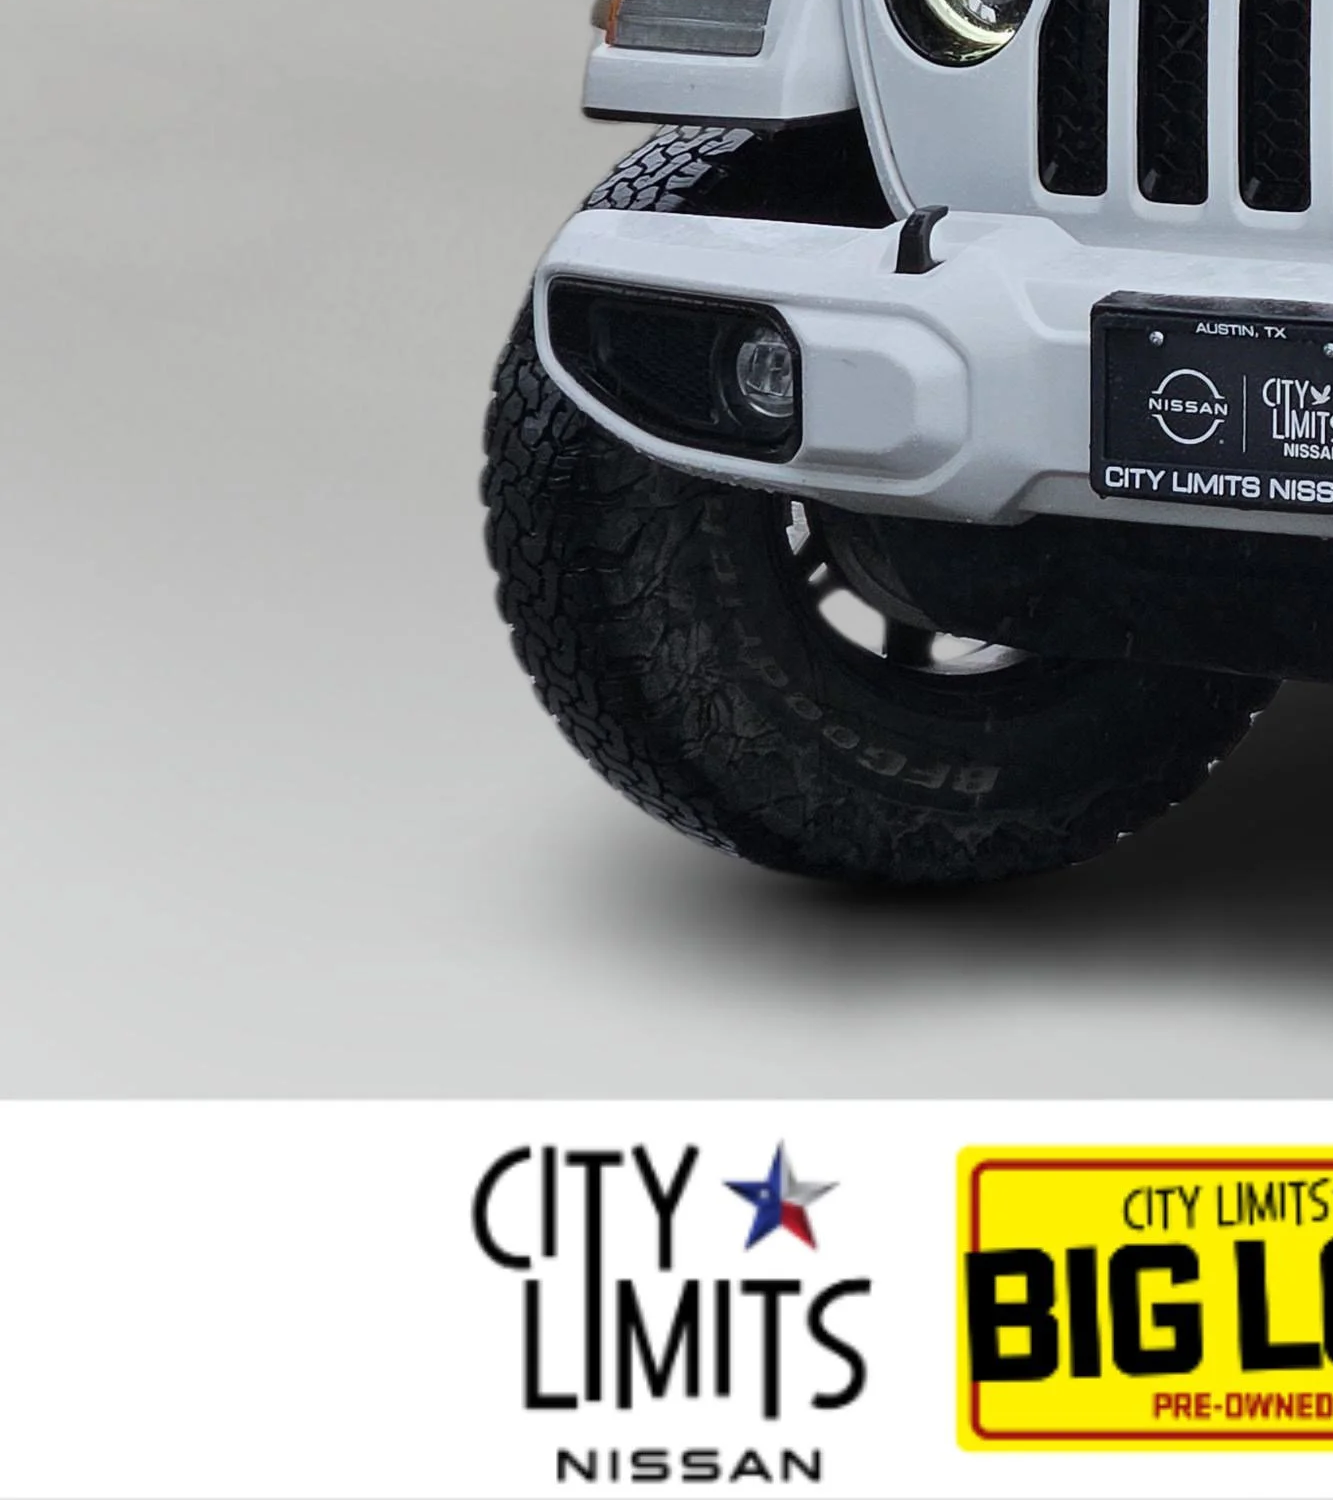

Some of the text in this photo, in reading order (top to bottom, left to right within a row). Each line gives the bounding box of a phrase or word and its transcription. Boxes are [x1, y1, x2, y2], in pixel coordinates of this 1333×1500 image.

[1195, 321, 1288, 340] AUSTIN, TX
[1262, 378, 1310, 409] CITY
[1148, 397, 1228, 417] NISSAN
[1104, 465, 1166, 491] CITY
[1171, 472, 1261, 498] LIMITS
